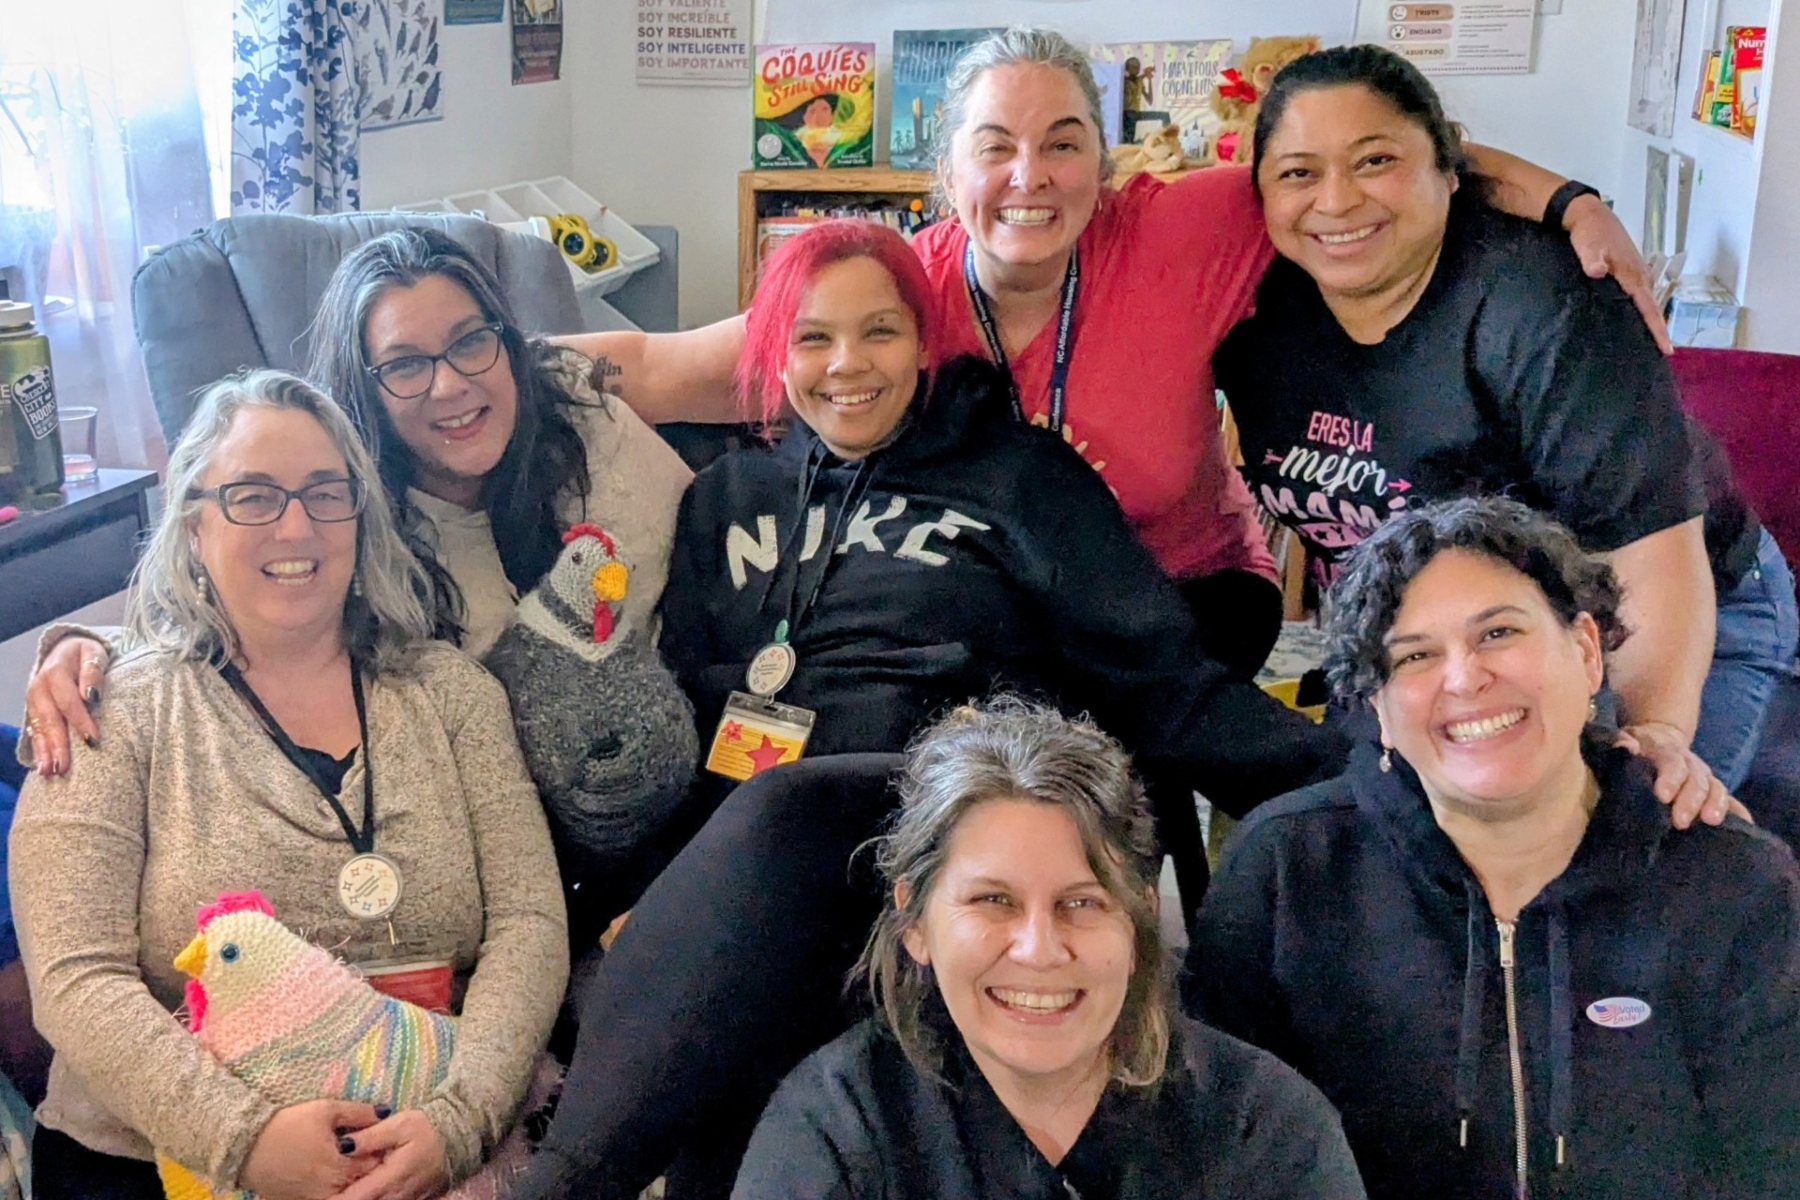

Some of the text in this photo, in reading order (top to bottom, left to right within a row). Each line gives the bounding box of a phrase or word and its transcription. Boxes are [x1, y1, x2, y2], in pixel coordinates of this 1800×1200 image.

[638, 0, 726, 8] SOY VALIENTE
[638, 9, 730, 24] SOY INCREÍBLE
[638, 27, 737, 39] SOY RESILIENTE
[638, 42, 746, 54] SOY INTELIGENTE
[780, 47, 797, 56] THE
[638, 57, 750, 69] SOY IMPORTANTE
[762, 45, 867, 85] COQUÍES
[1162, 61, 1219, 79] MARVELOUS
[768, 79, 808, 107] STILL
[1063, 276, 1078, 309] Housing
[1058, 310, 1070, 351] Affordable
[1057, 351, 1065, 364] NC
[25, 396, 45, 413] CITY
[1052, 387, 1061, 432] Conference
[1306, 411, 1374, 453] ERES LA
[1279, 445, 1388, 497] mejor
[726, 495, 991, 591] NIKE
[1619, 1003, 1645, 1013] Voted
